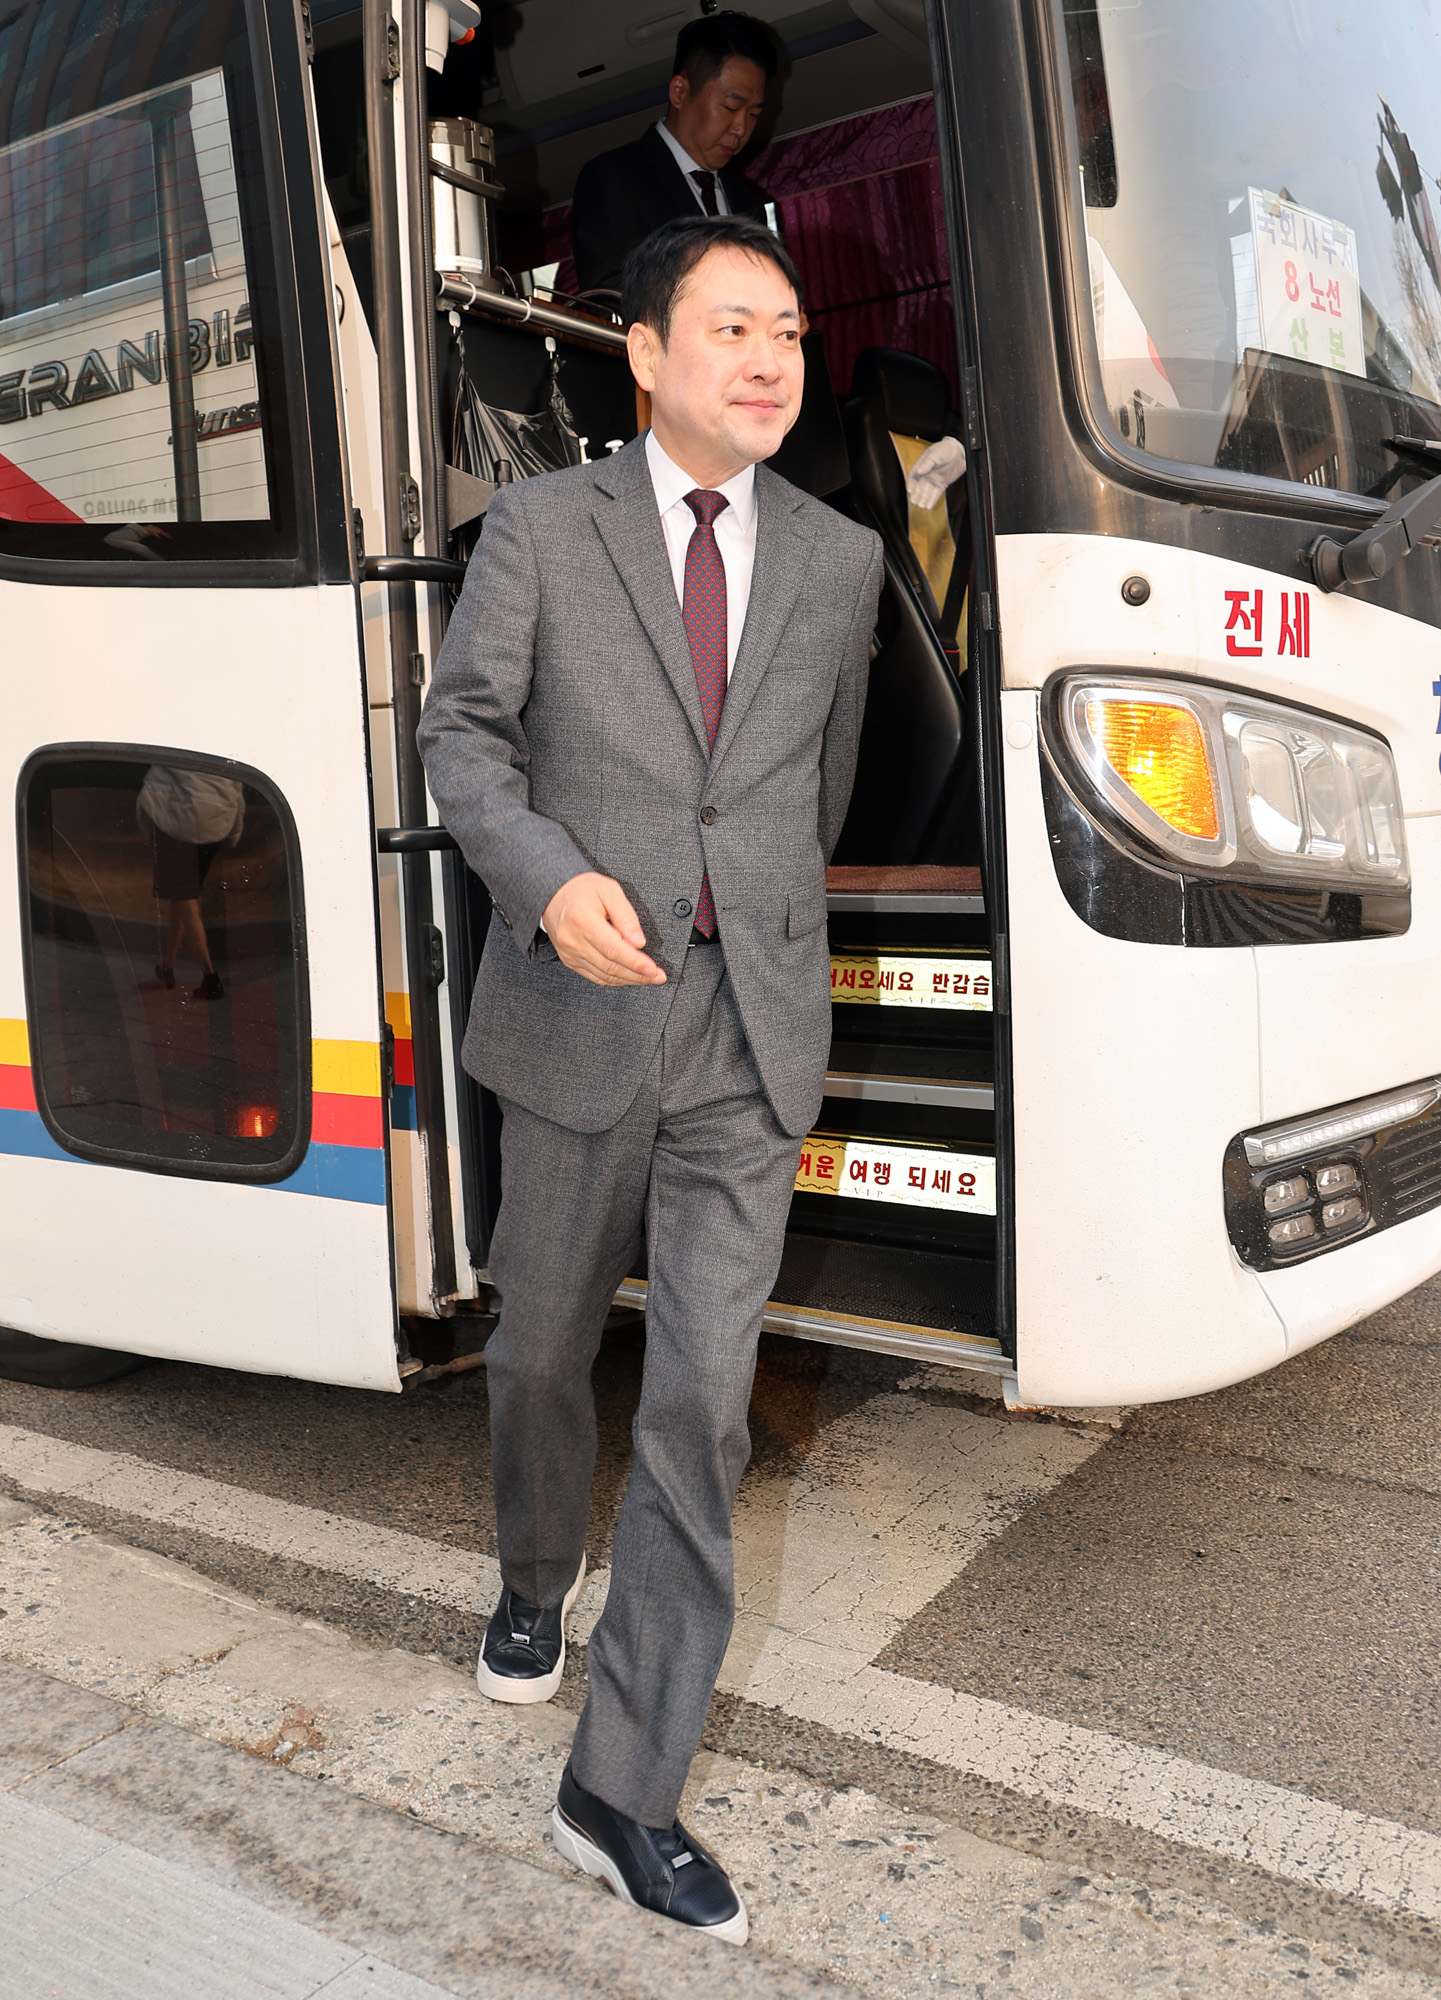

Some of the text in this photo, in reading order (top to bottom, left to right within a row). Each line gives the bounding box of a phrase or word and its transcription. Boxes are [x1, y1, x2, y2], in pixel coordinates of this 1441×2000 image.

[1284, 260, 1342, 318] 8 노선
[932, 973, 990, 996] 반갑습
[849, 1160, 891, 1185] 여행
[907, 1166, 976, 1196] 되세요
